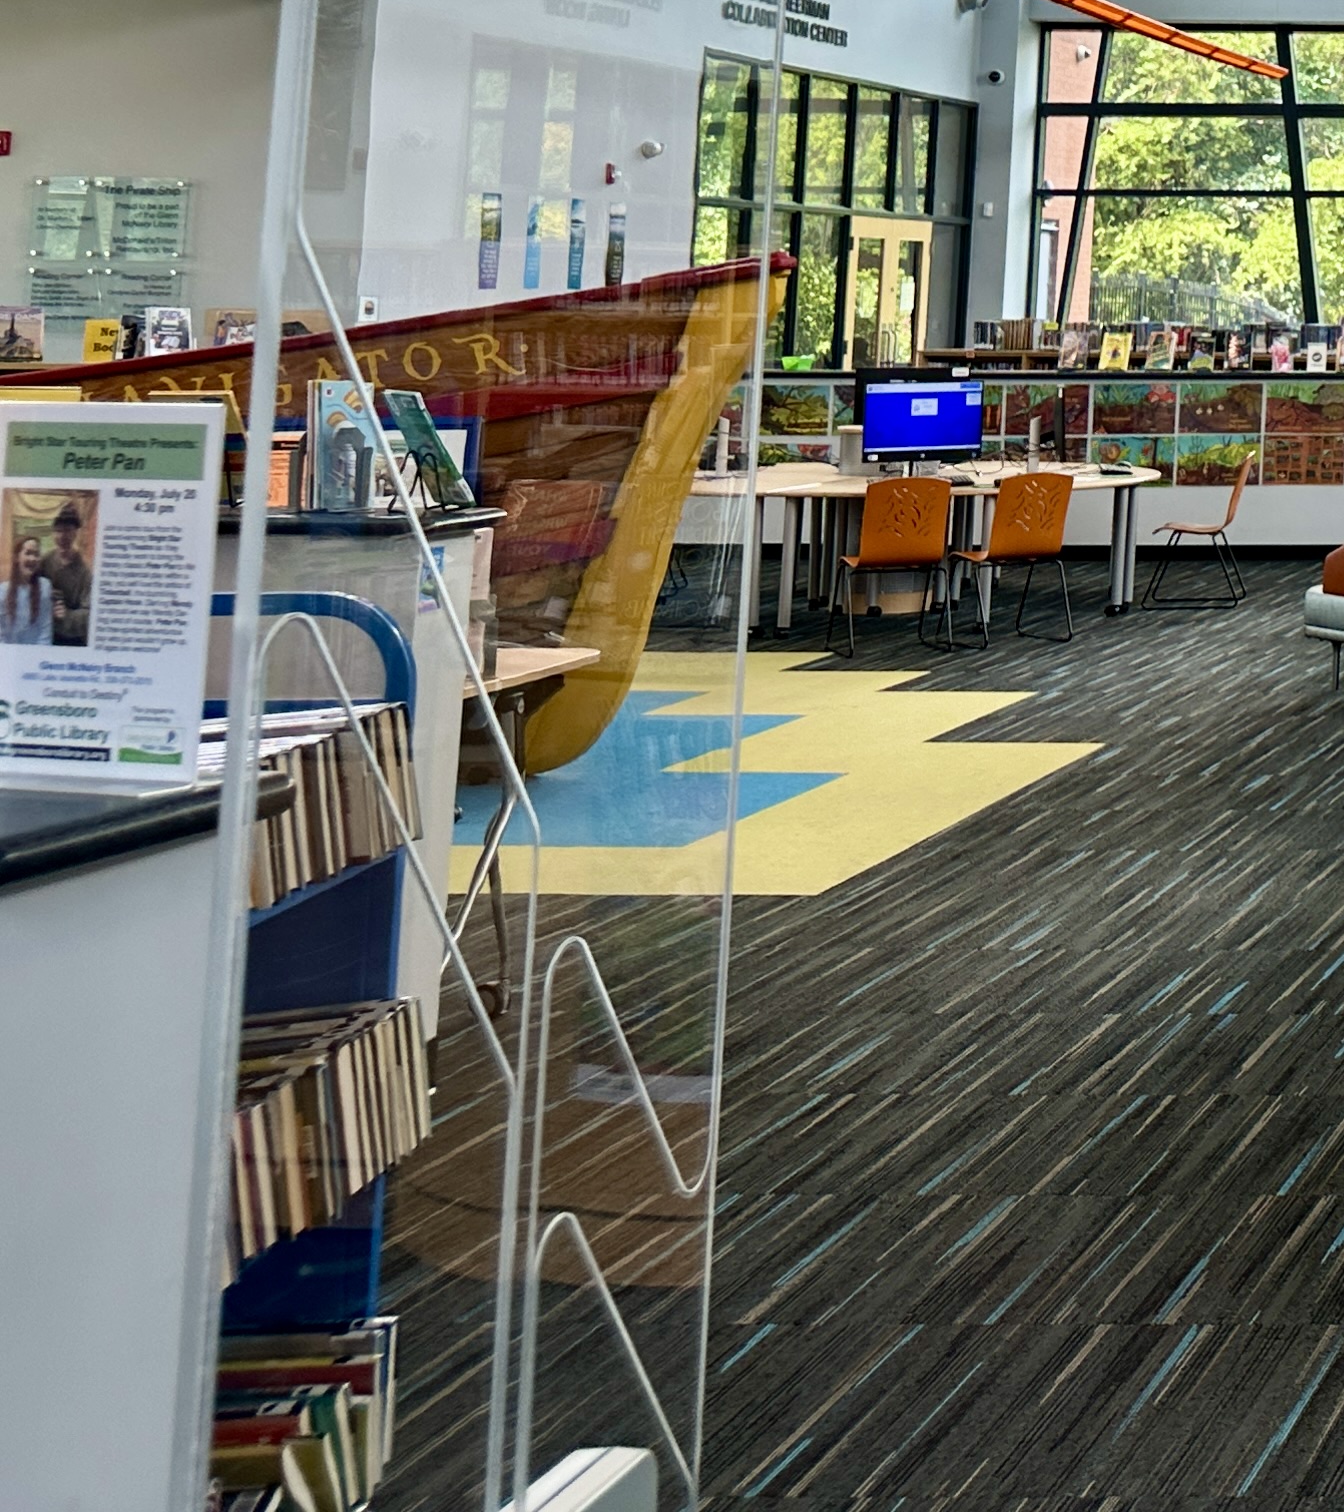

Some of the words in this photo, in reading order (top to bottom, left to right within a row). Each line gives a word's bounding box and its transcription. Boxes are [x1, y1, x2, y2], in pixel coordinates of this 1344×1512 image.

[809, 22, 849, 47] CENTER
[157, 185, 181, 197] Ship
[63, 451, 109, 470] Peter
[111, 452, 146, 471] Pan
[159, 488, 181, 502] July
[14, 700, 99, 718] Greensboro
[12, 722, 57, 739] Public
[60, 724, 111, 746] Library
